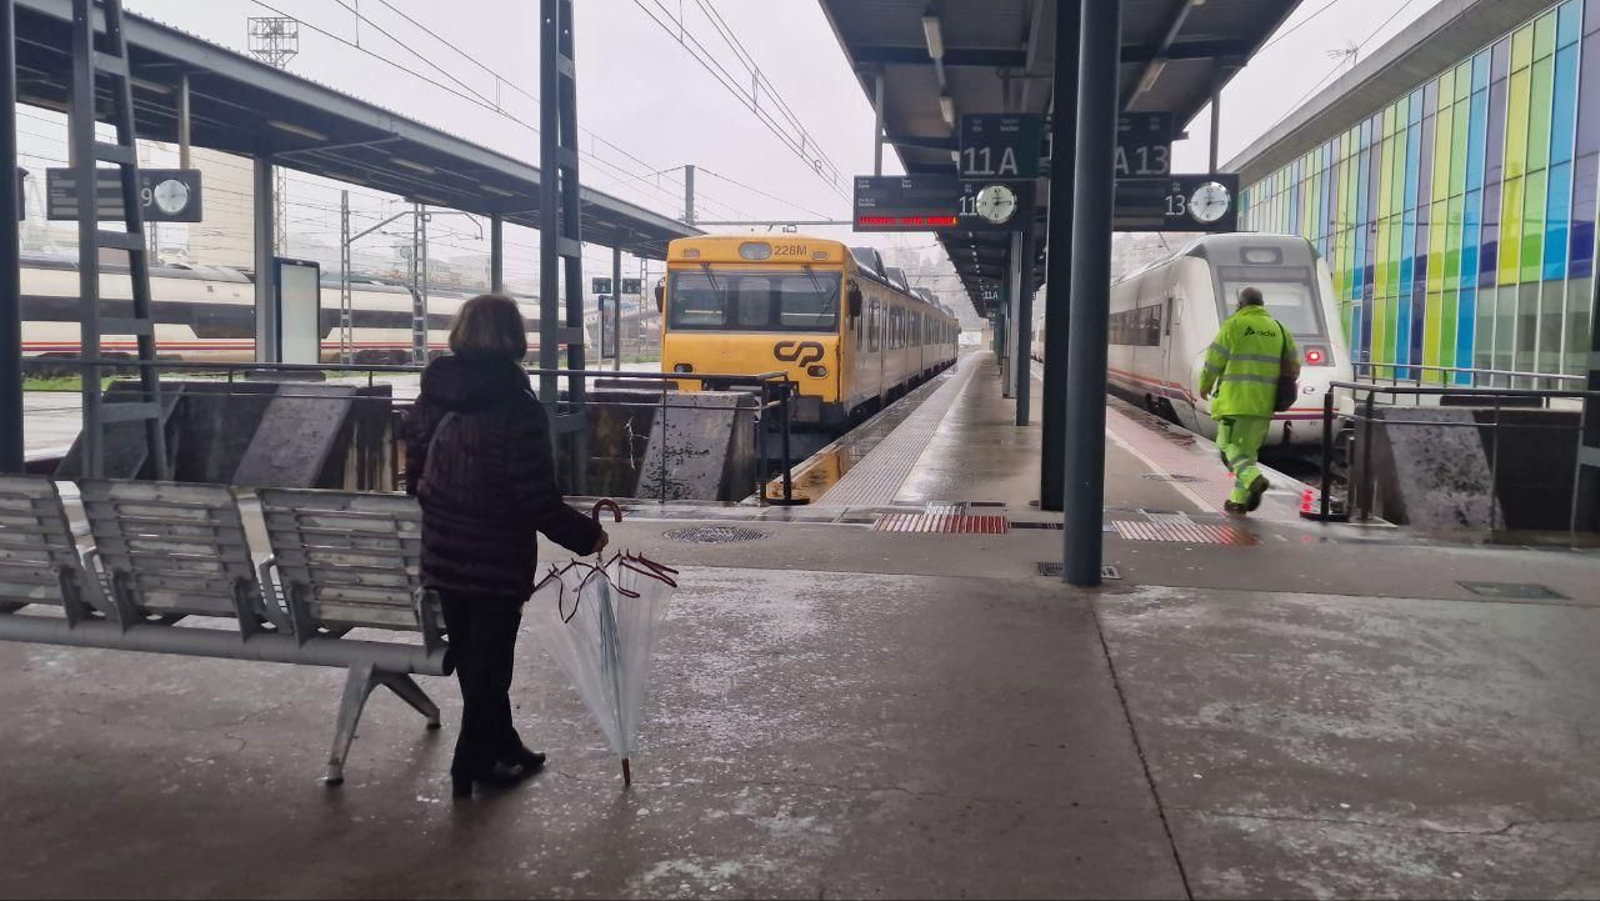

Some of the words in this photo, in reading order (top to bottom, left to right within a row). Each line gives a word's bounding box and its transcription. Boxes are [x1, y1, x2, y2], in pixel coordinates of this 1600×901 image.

[964, 147, 995, 175] 11
[998, 147, 1018, 175] A
[1115, 146, 1130, 175] A
[1136, 145, 1169, 175] 13
[140, 188, 153, 207] 9
[959, 195, 978, 216] 11
[1164, 194, 1187, 216] 13
[774, 245, 807, 256] 228M
[774, 340, 824, 367] CP
